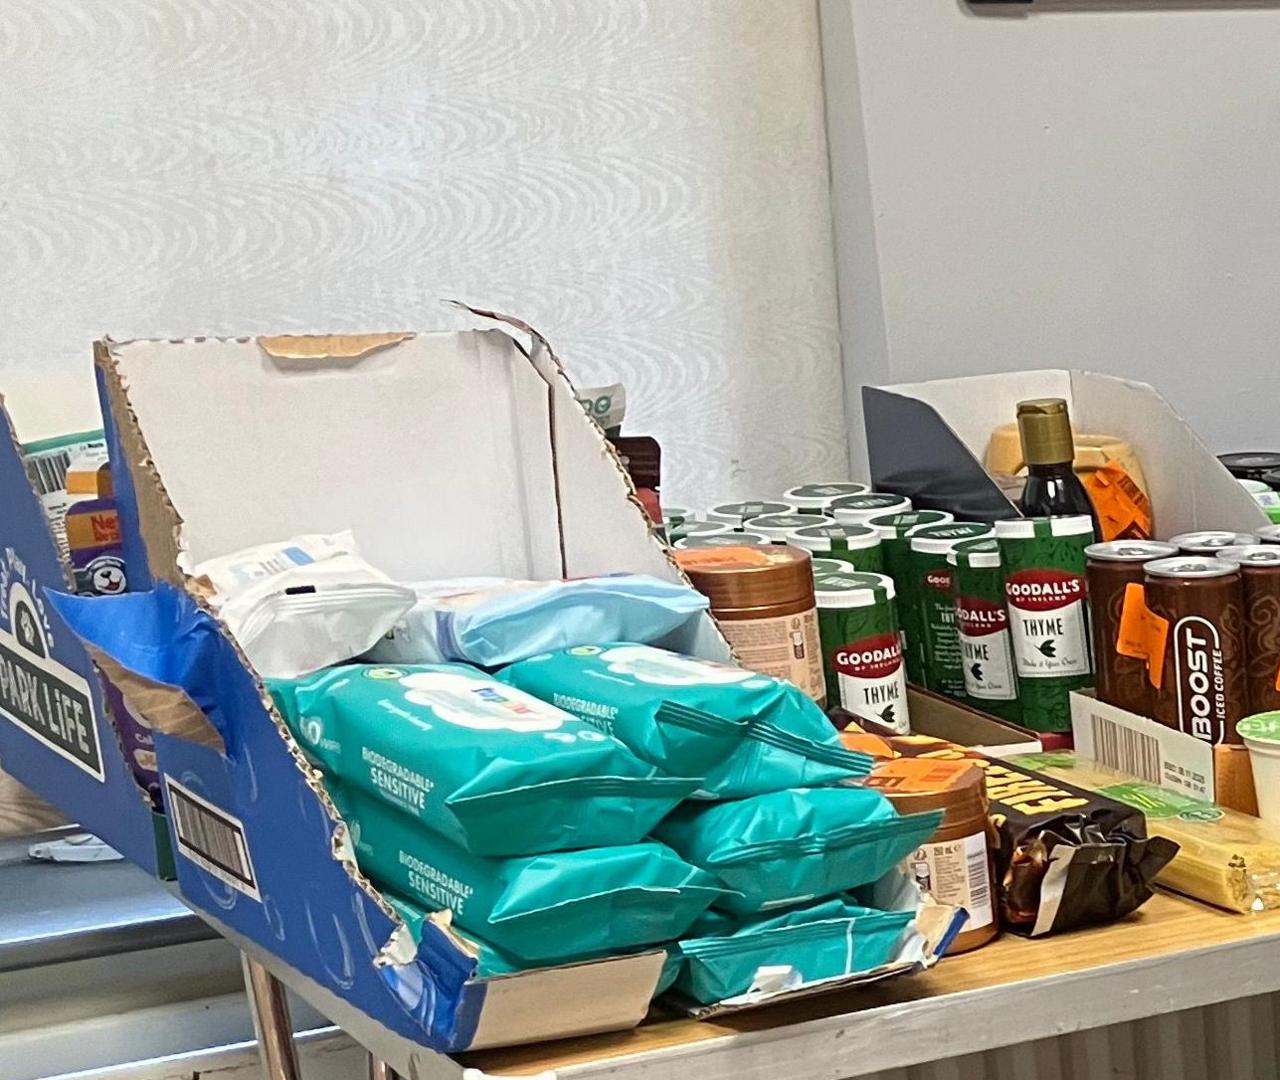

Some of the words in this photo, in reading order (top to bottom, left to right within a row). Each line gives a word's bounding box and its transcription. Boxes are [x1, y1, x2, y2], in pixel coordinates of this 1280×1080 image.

[1006, 579, 1080, 605] GOODALL'S
[1022, 618, 1065, 639] THYME
[1184, 627, 1213, 742] BOOST
[1213, 648, 1224, 687] COFFEE
[863, 681, 900, 706] THYME
[1215, 686, 1226, 720] ICED
[370, 765, 426, 811] SENSITIVE
[408, 868, 464, 917] SENSITIVE
